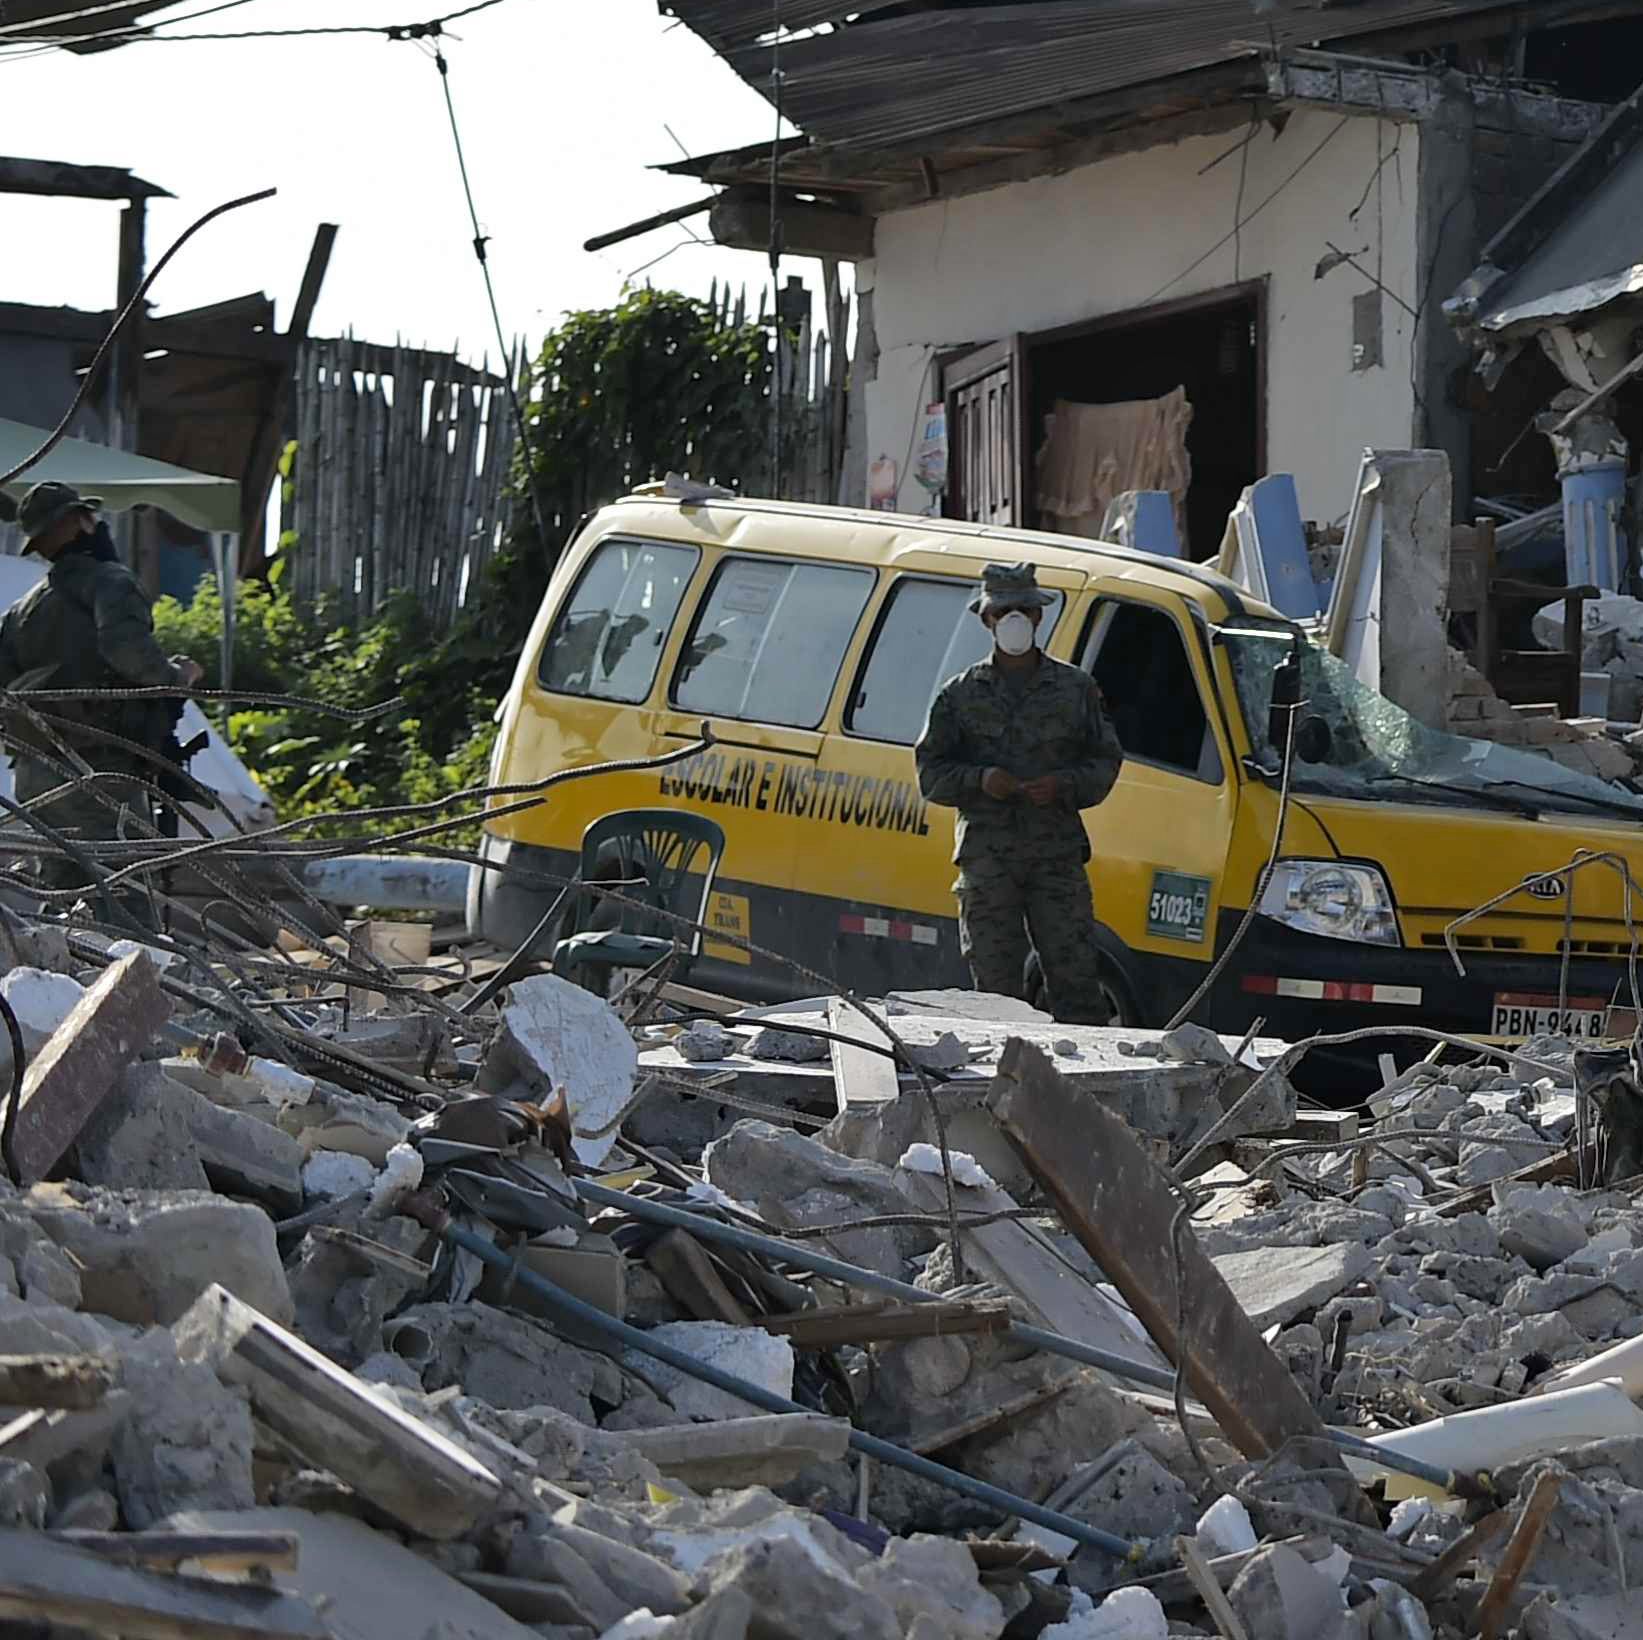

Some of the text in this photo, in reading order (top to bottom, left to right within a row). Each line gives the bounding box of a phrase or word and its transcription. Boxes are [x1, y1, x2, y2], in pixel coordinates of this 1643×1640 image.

[659, 753, 930, 837] ESCOLAR E INSTITUCIONAL
[1150, 892, 1193, 925] 51023
